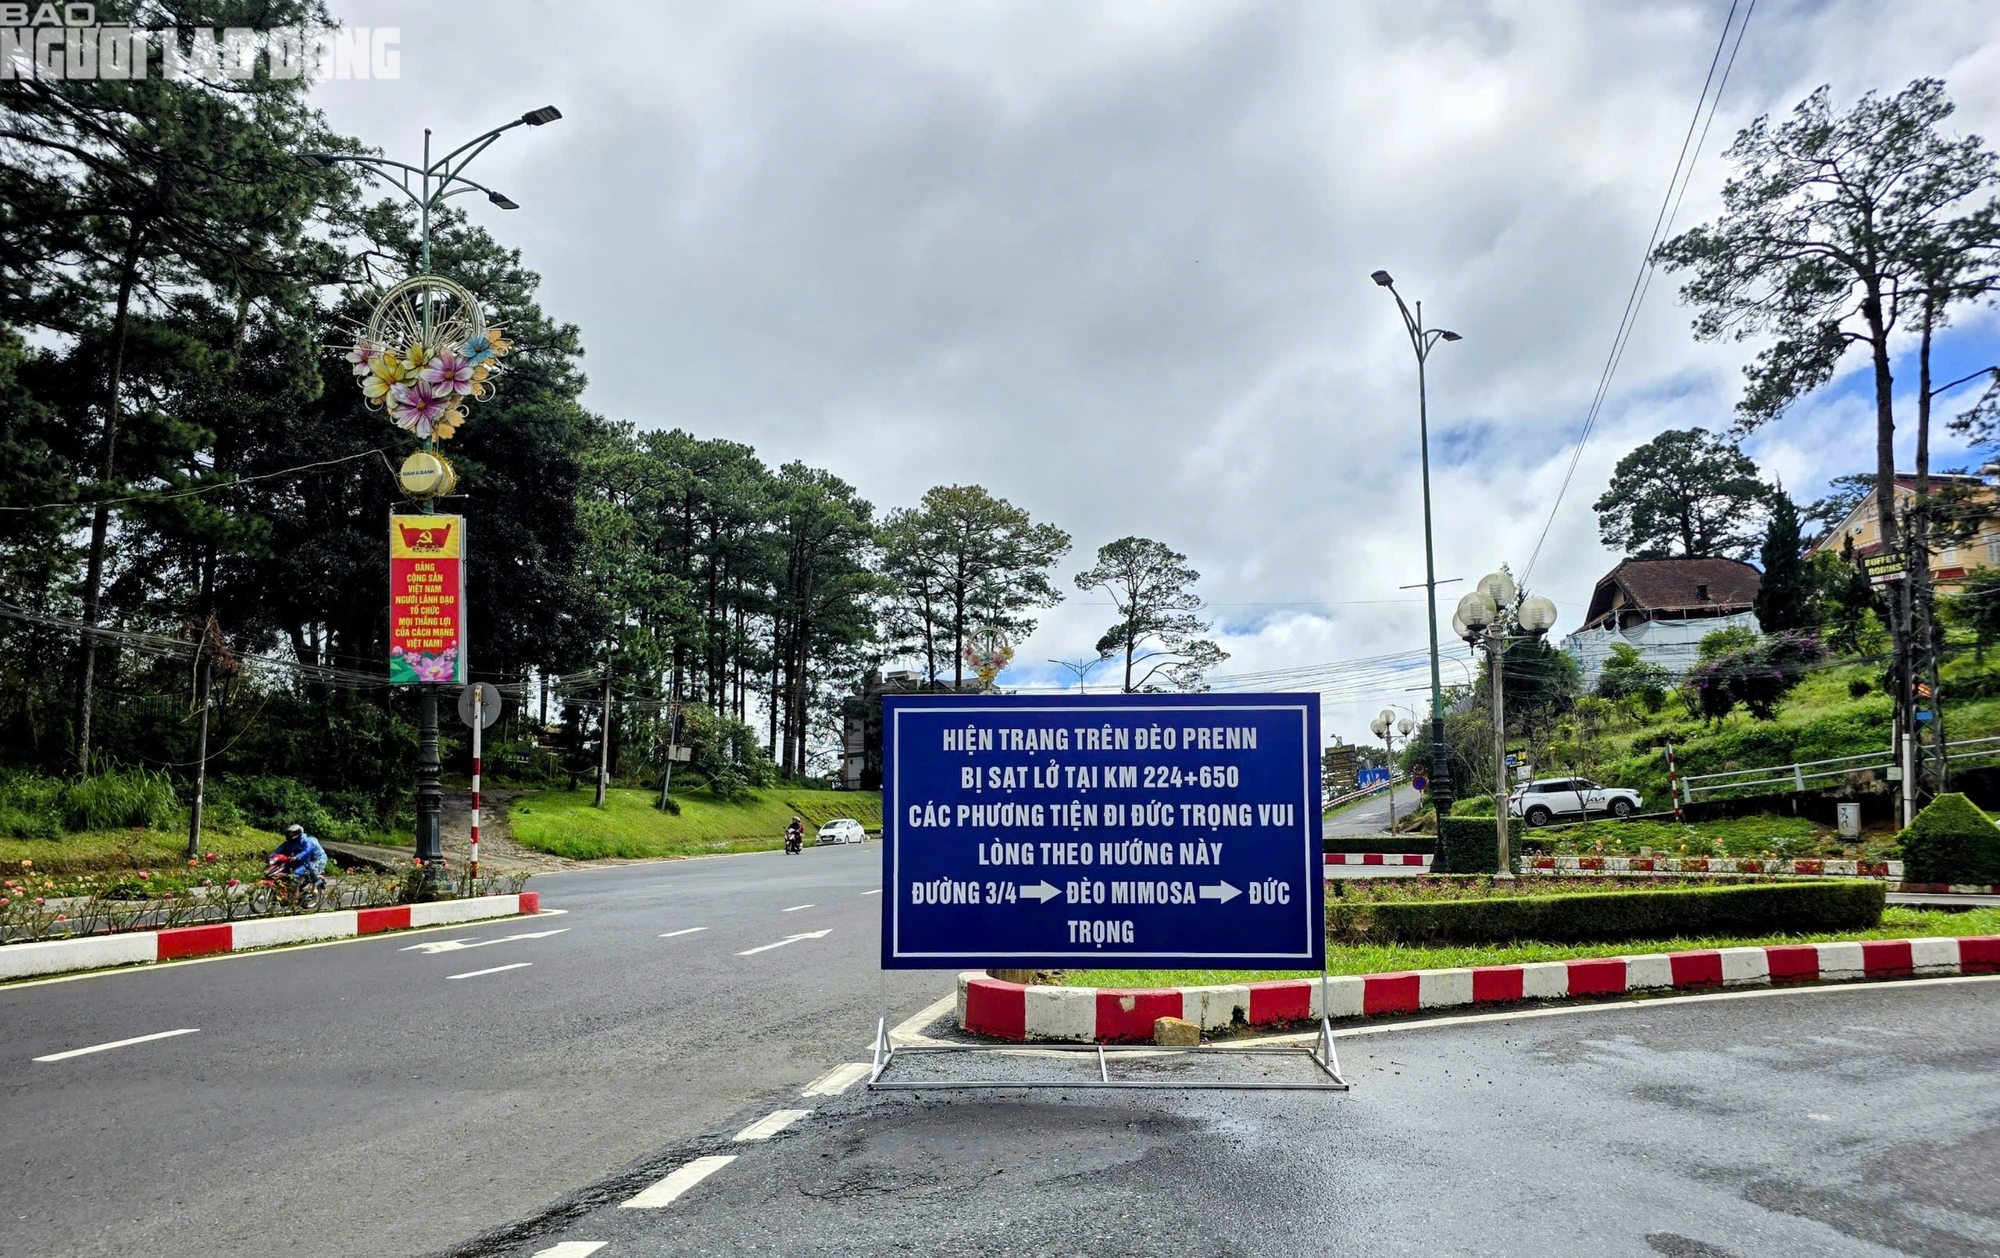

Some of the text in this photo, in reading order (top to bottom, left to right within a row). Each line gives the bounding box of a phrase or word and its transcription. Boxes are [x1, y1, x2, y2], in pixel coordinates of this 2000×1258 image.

[415, 561, 435, 571] ĐẢNG
[1864, 554, 1896, 567] BUFFET
[406, 572, 443, 583] CỘNG SẢN
[408, 583, 442, 594] VIỆT NAM
[395, 594, 455, 605] NGƯỜI LÃNH ĐẠO
[420, 605, 440, 615] CHỨC
[399, 615, 451, 627] MỌI THẮNG LỢI
[395, 626, 454, 638] CỦA CÁCH MẠNG
[406, 638, 443, 649] VIỆT NAM!
[943, 723, 1257, 755] HIỆN TRẠNG TRÊN ĐÈO PRENN
[961, 759, 1239, 793] BỊ SẠT LỞ TẠI KM 224+650
[908, 800, 1294, 831] CÁC PHƯƠNG TIỆN ĐI ĐỨC TRỌNG VUI
[978, 838, 1223, 866] LÒNG THEO HƯỚNG NÀY
[911, 876, 1290, 905] ĐƯỜNG 3/4 ĐÈO MIMOSA ĐỨC
[1067, 920, 1134, 948] TRỌNG
